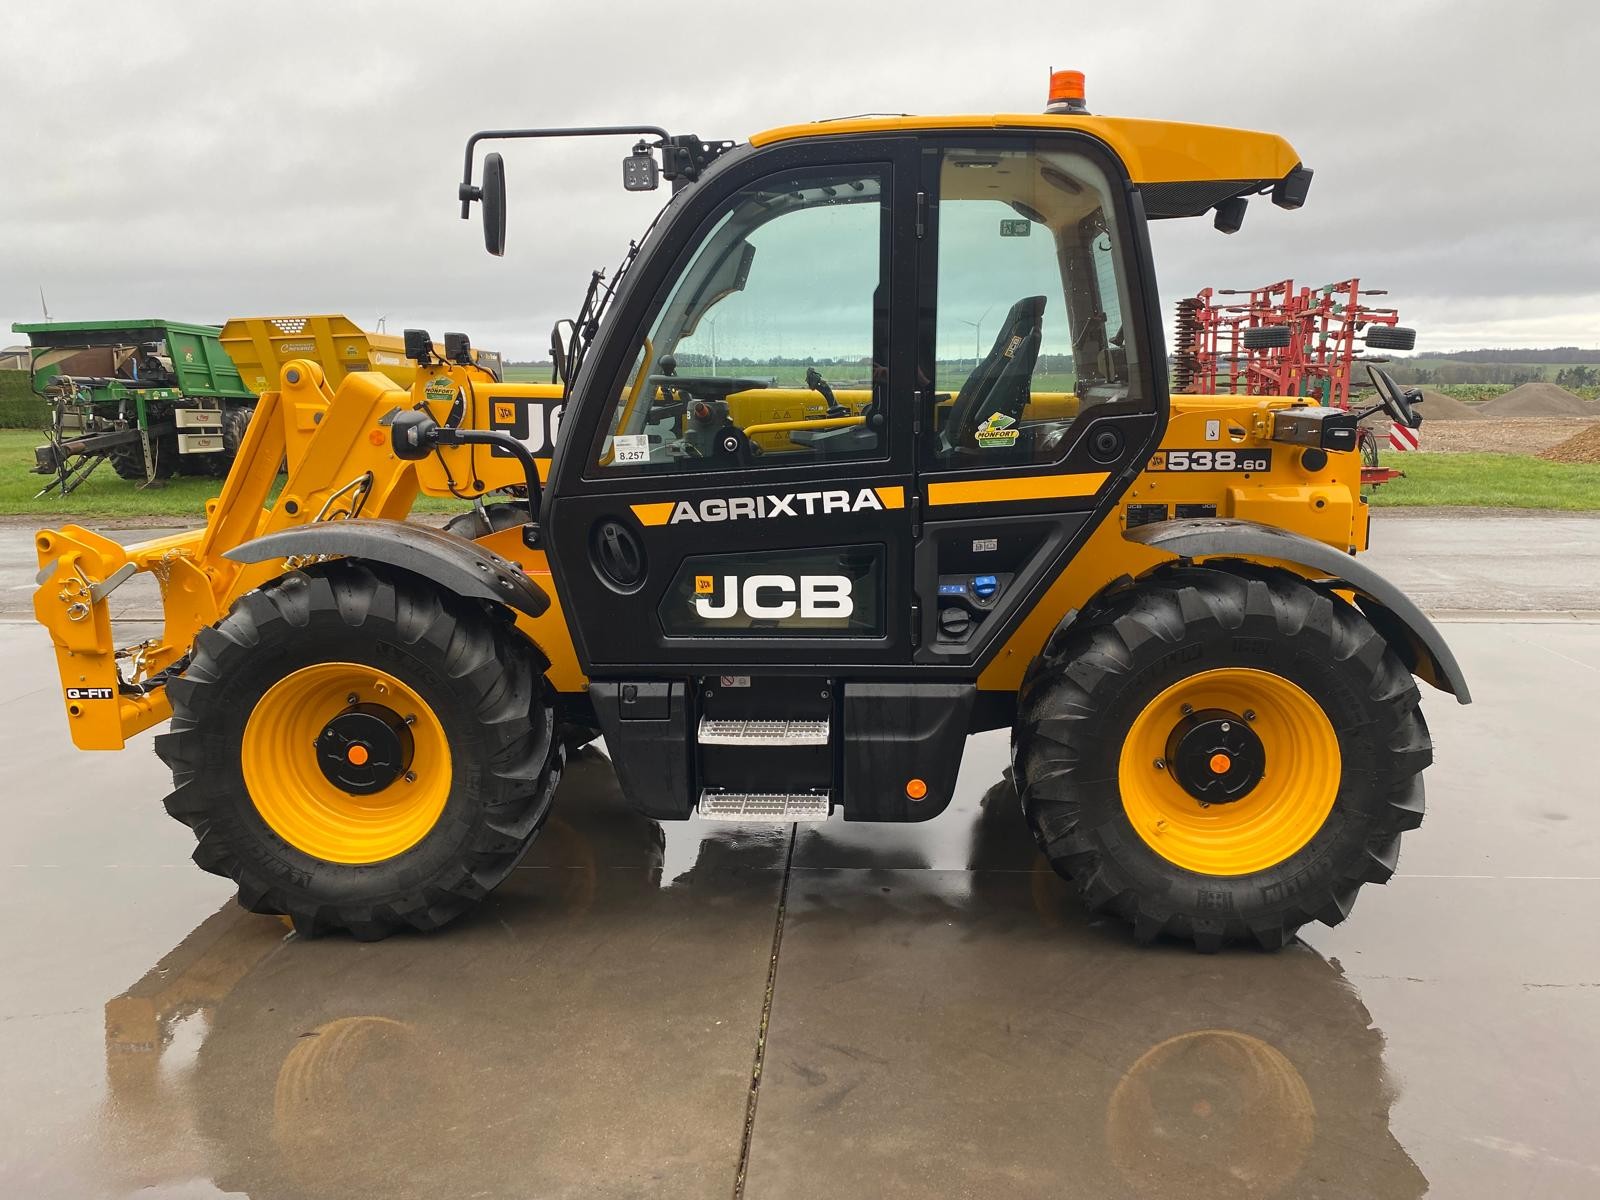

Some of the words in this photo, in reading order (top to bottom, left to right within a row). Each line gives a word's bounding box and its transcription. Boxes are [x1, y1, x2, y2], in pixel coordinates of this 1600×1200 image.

[497, 407, 512, 418] JCB
[977, 430, 1016, 438] MONFORT
[619, 451, 645, 461] 8.257
[670, 488, 883, 525] AGRIXTRA
[695, 574, 853, 619] JCB
[68, 688, 112, 698] Q-FIT
